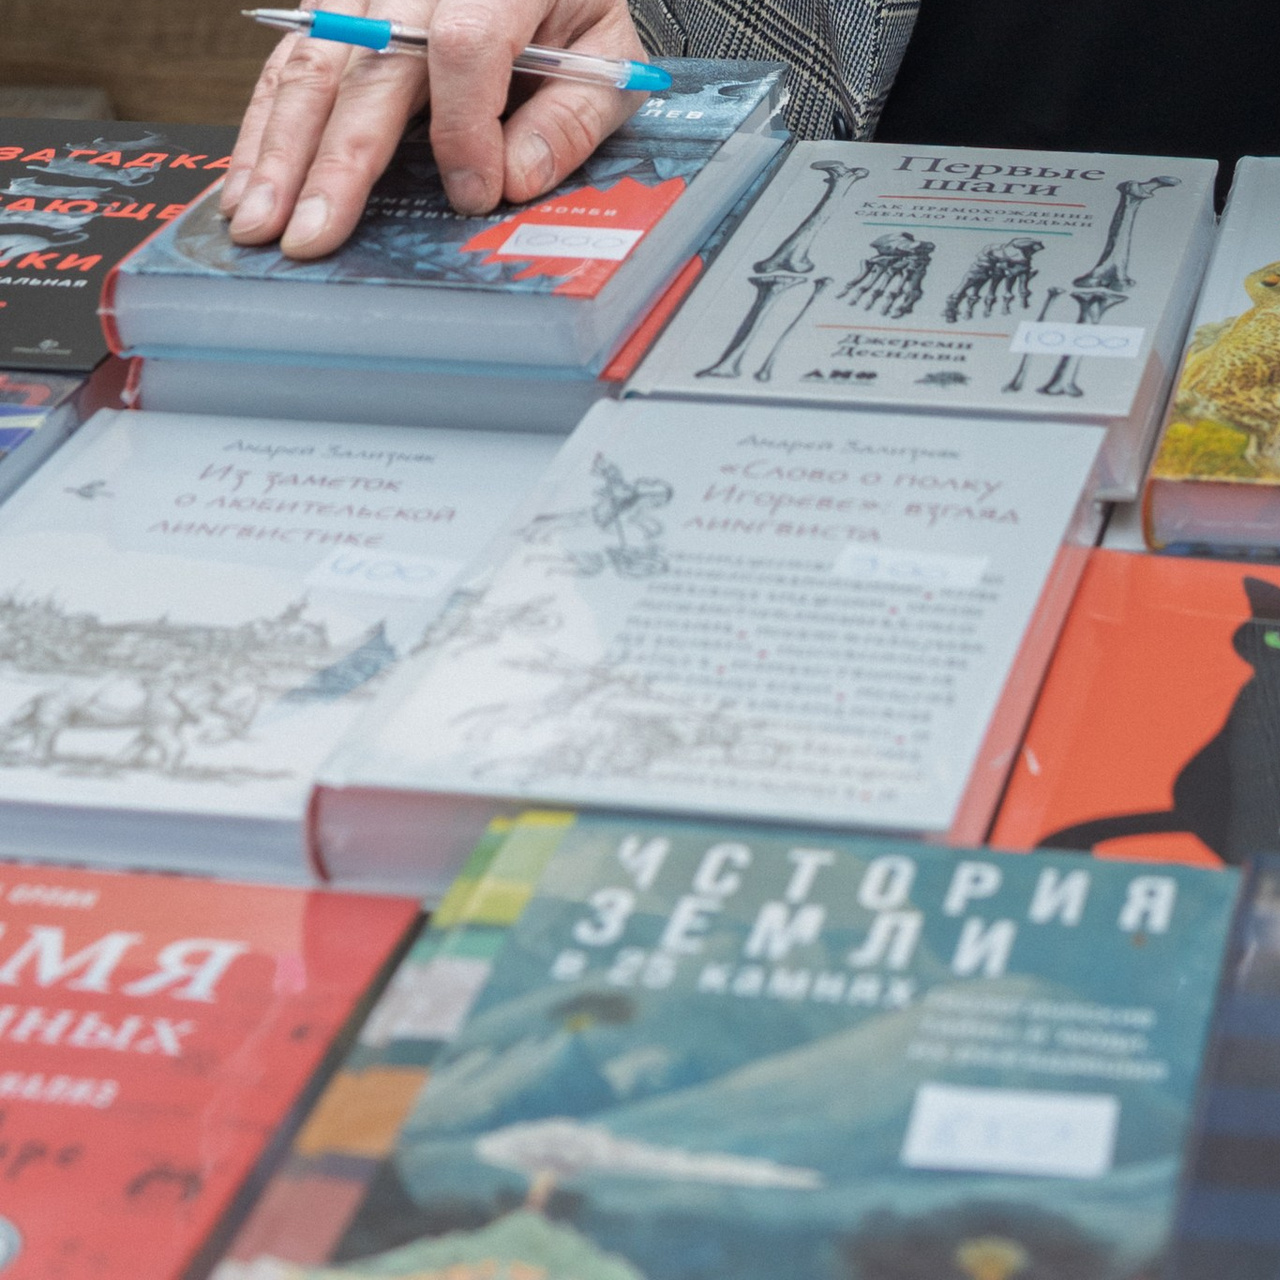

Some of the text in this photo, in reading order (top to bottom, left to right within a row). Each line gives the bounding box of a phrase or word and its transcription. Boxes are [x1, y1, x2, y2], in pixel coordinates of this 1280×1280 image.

[894, 155, 1106, 182] Первые
[918, 177, 1063, 197] шаги
[854, 209, 1095, 228] СДЕЛАЛО НАС ЛЮДЬМИ
[911, 205, 1094, 220] ПРЯМОХОЖДЕНИЕ
[837, 333, 974, 351] Джереми
[830, 345, 968, 363] Десильва
[572, 886, 1018, 981] ЗЕМЛИ
